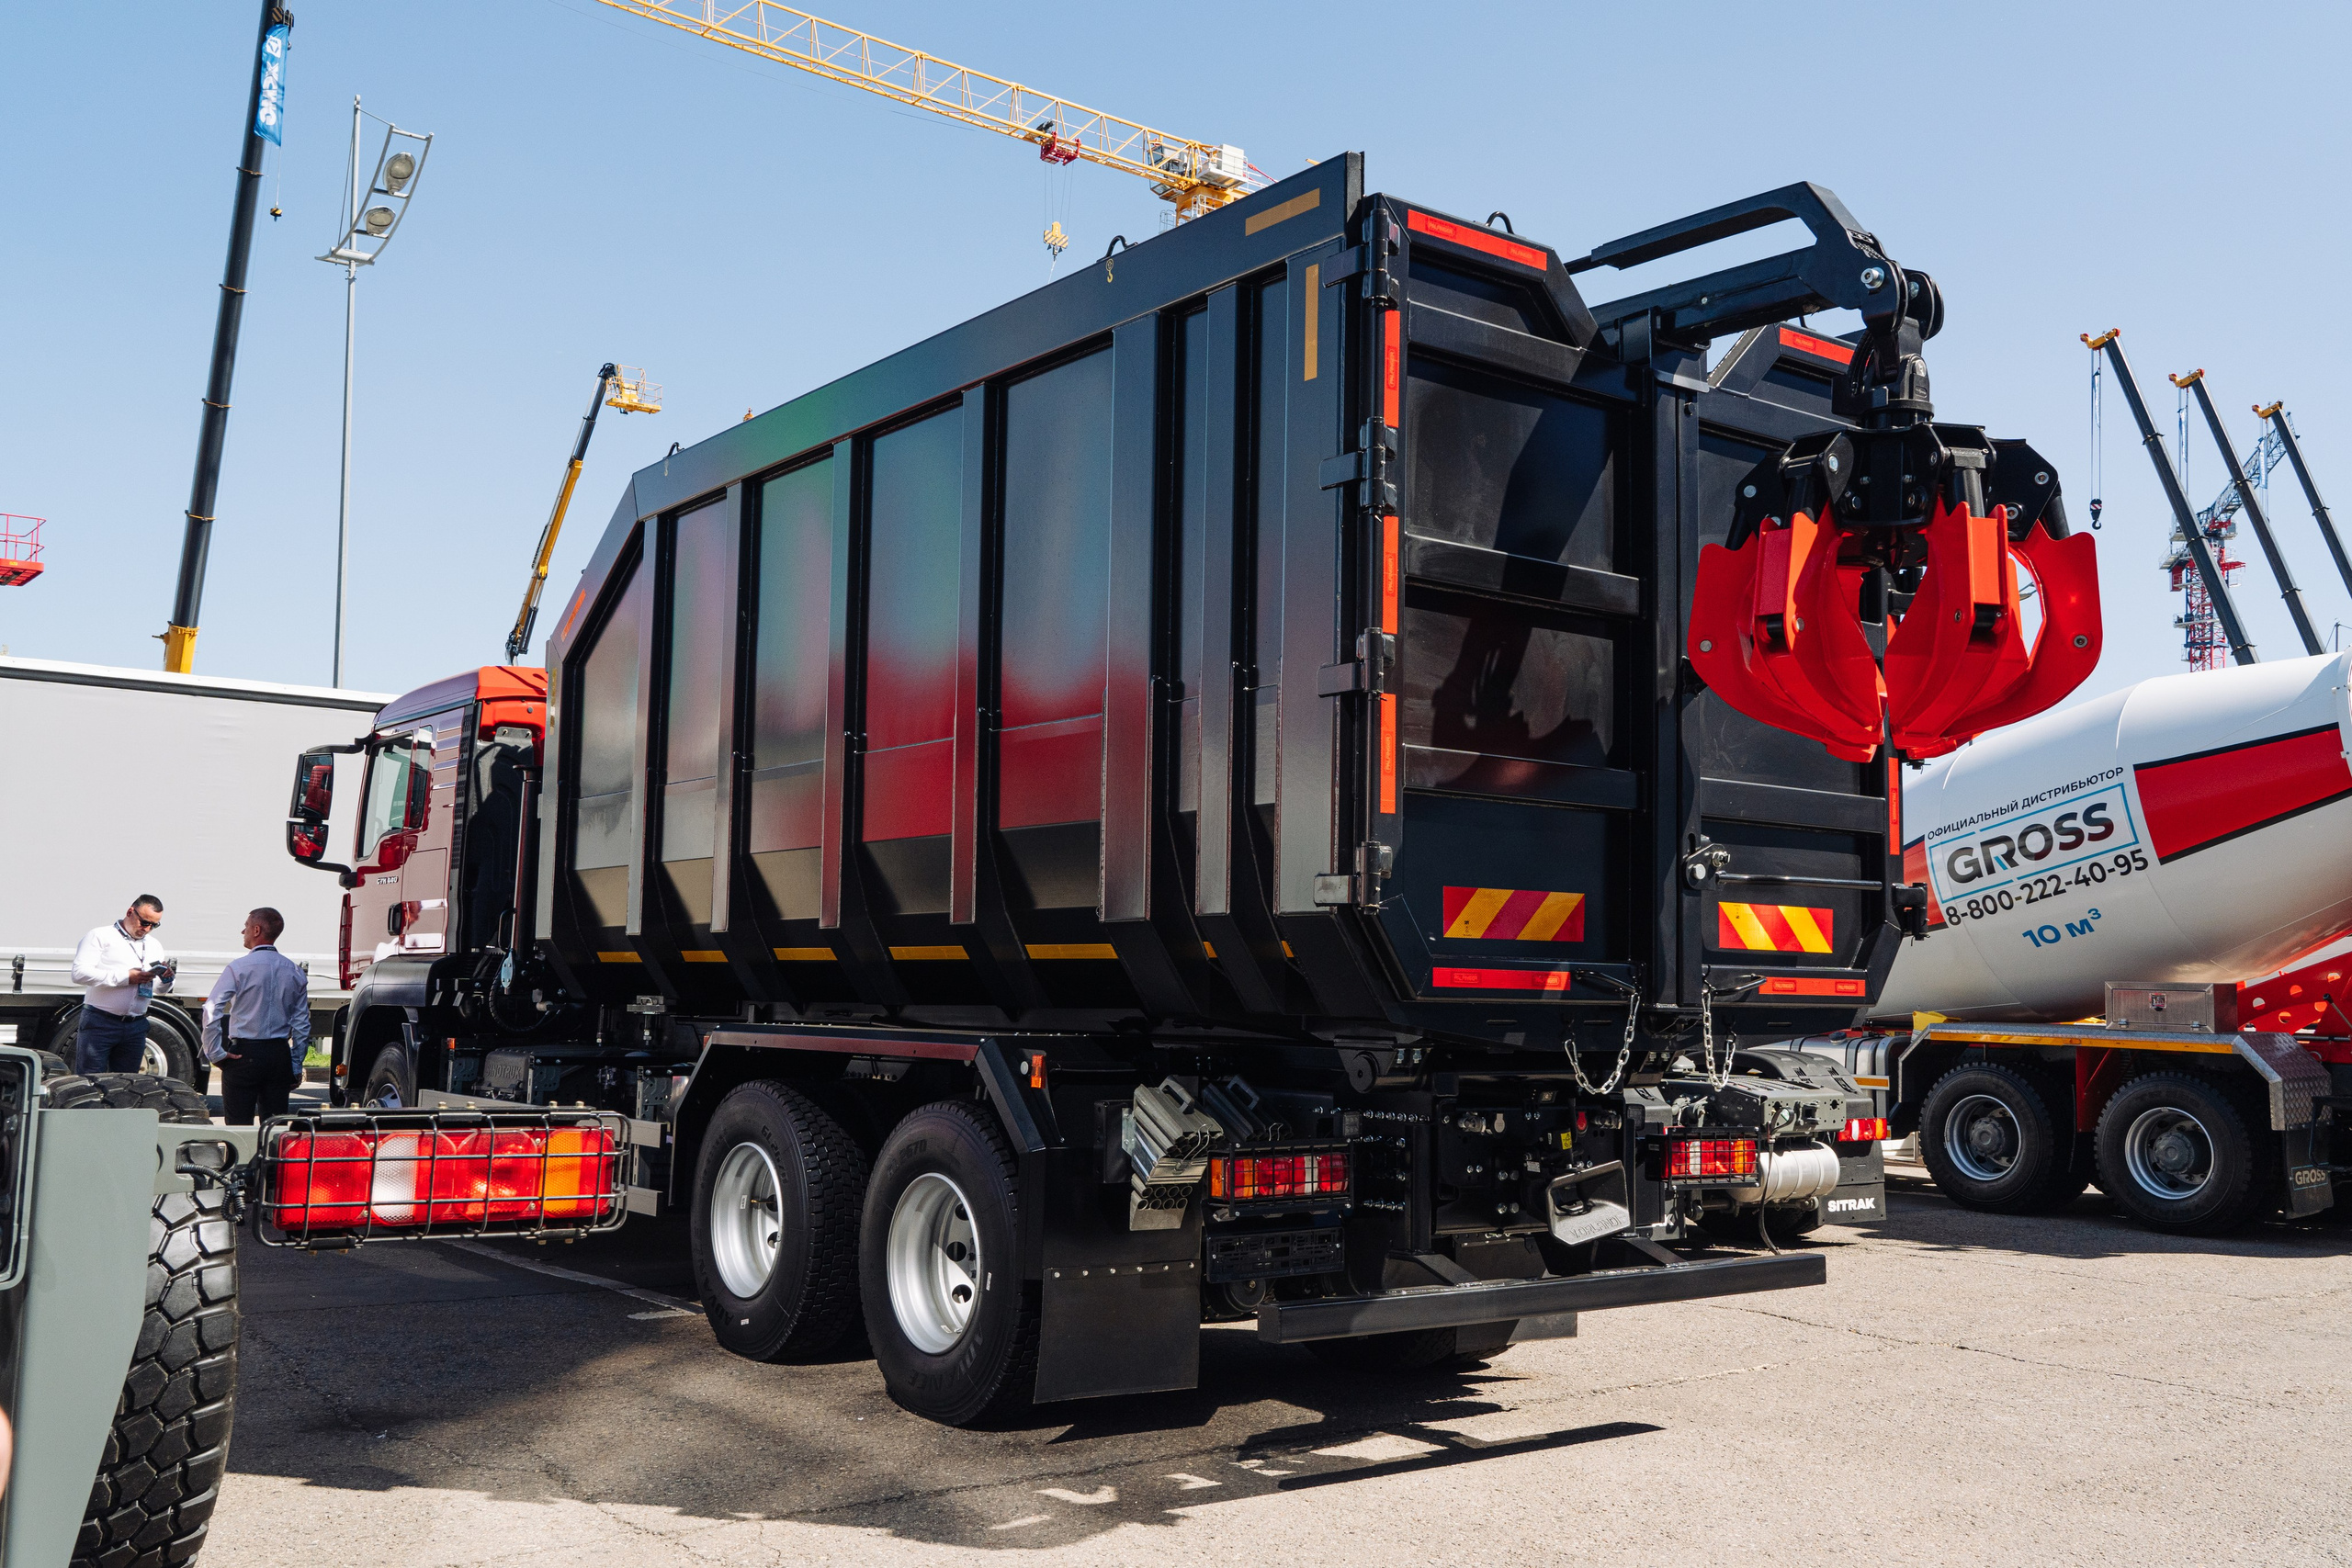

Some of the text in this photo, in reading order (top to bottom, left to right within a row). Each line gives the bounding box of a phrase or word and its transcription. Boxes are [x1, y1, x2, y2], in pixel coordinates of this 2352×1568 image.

[1927, 766, 2124, 841] ОФИЦИАЛЬНЫЙ ДИСТРИБЬЮТОР
[1946, 802, 2115, 884] GROSS
[1945, 849, 2149, 927] 8-800-222-40-95
[2022, 923, 2062, 949] 10
[486, 1064, 522, 1080] SINOTRUK
[2294, 1168, 2327, 1186] GROSS
[1827, 1197, 1875, 1213] SITRAK
